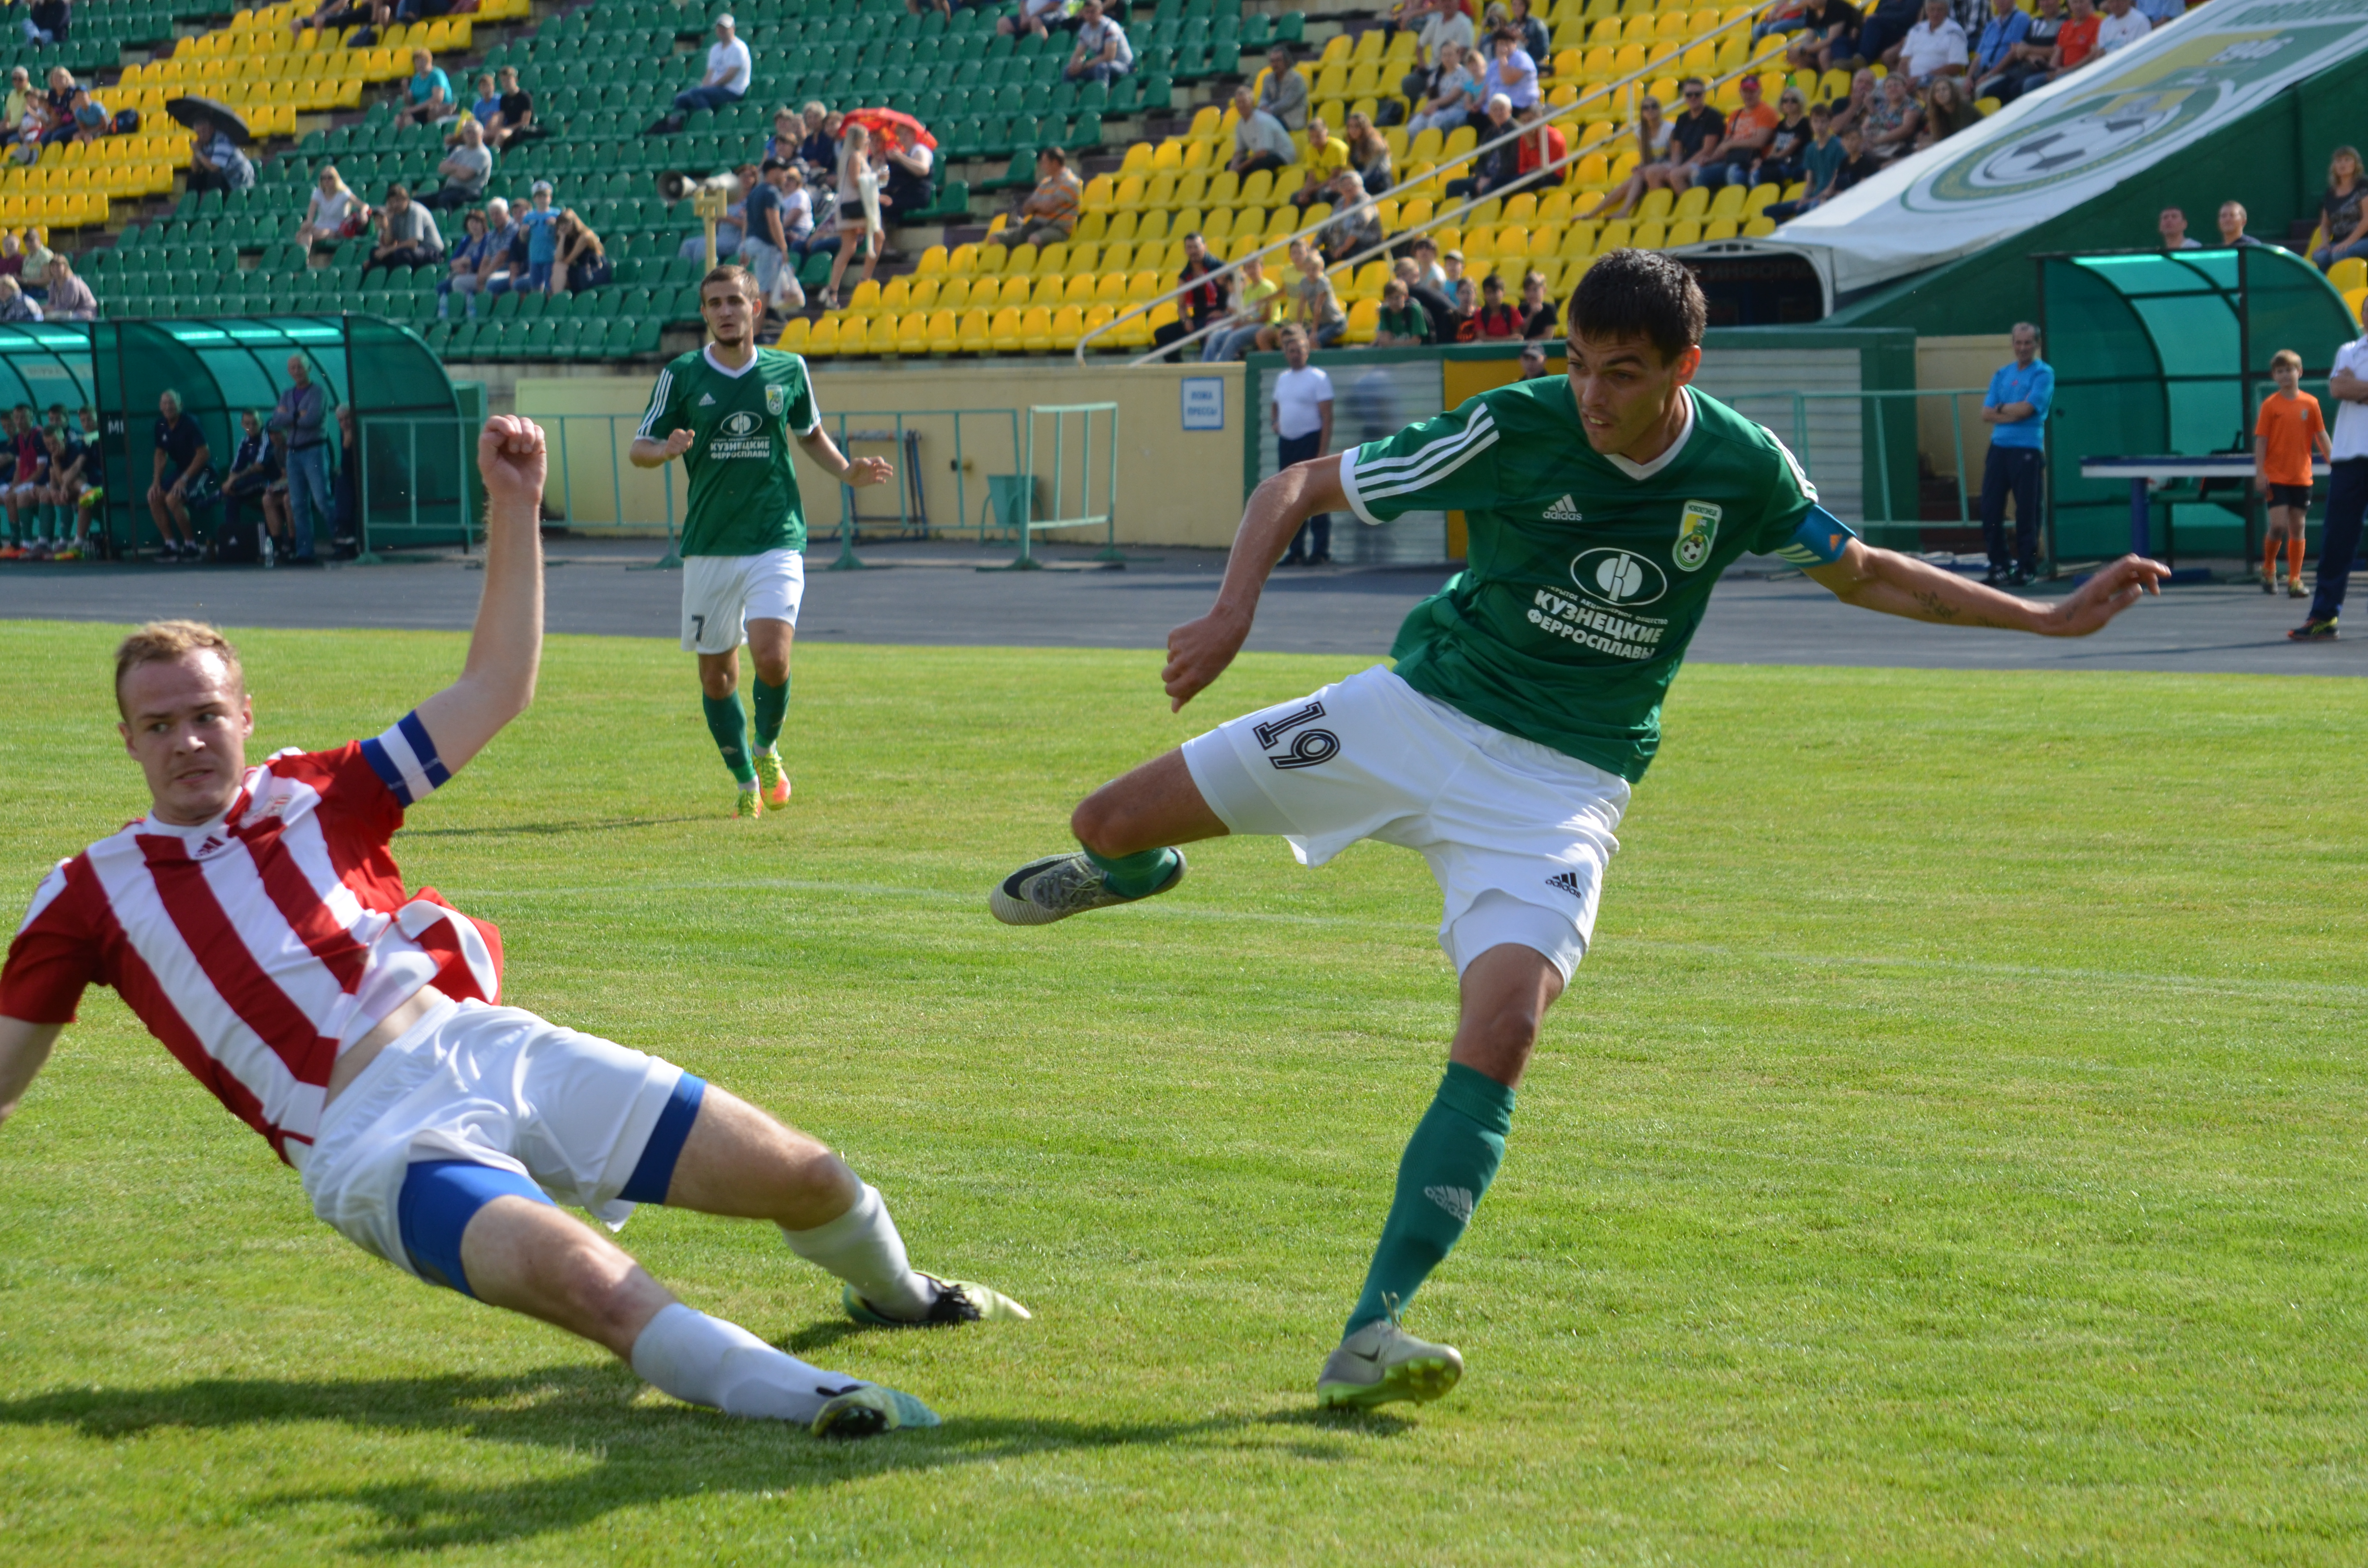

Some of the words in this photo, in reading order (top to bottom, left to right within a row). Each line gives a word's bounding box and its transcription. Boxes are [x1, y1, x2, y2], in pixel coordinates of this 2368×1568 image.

[710, 440, 770, 451] КУЗНЕЦКИЕ
[711, 450, 770, 459] ФЕРРОСПЛАВЫ
[1543, 510, 1582, 521] adidas
[691, 614, 705, 642] 7
[1534, 589, 1665, 643] КУЗНЕЦКИЕ
[1528, 609, 1656, 660] ФЕРРОСПЛАВЫ
[1252, 700, 1340, 770] 19
[1545, 878, 1581, 899] adidas
[1424, 1185, 1472, 1226] adidas
